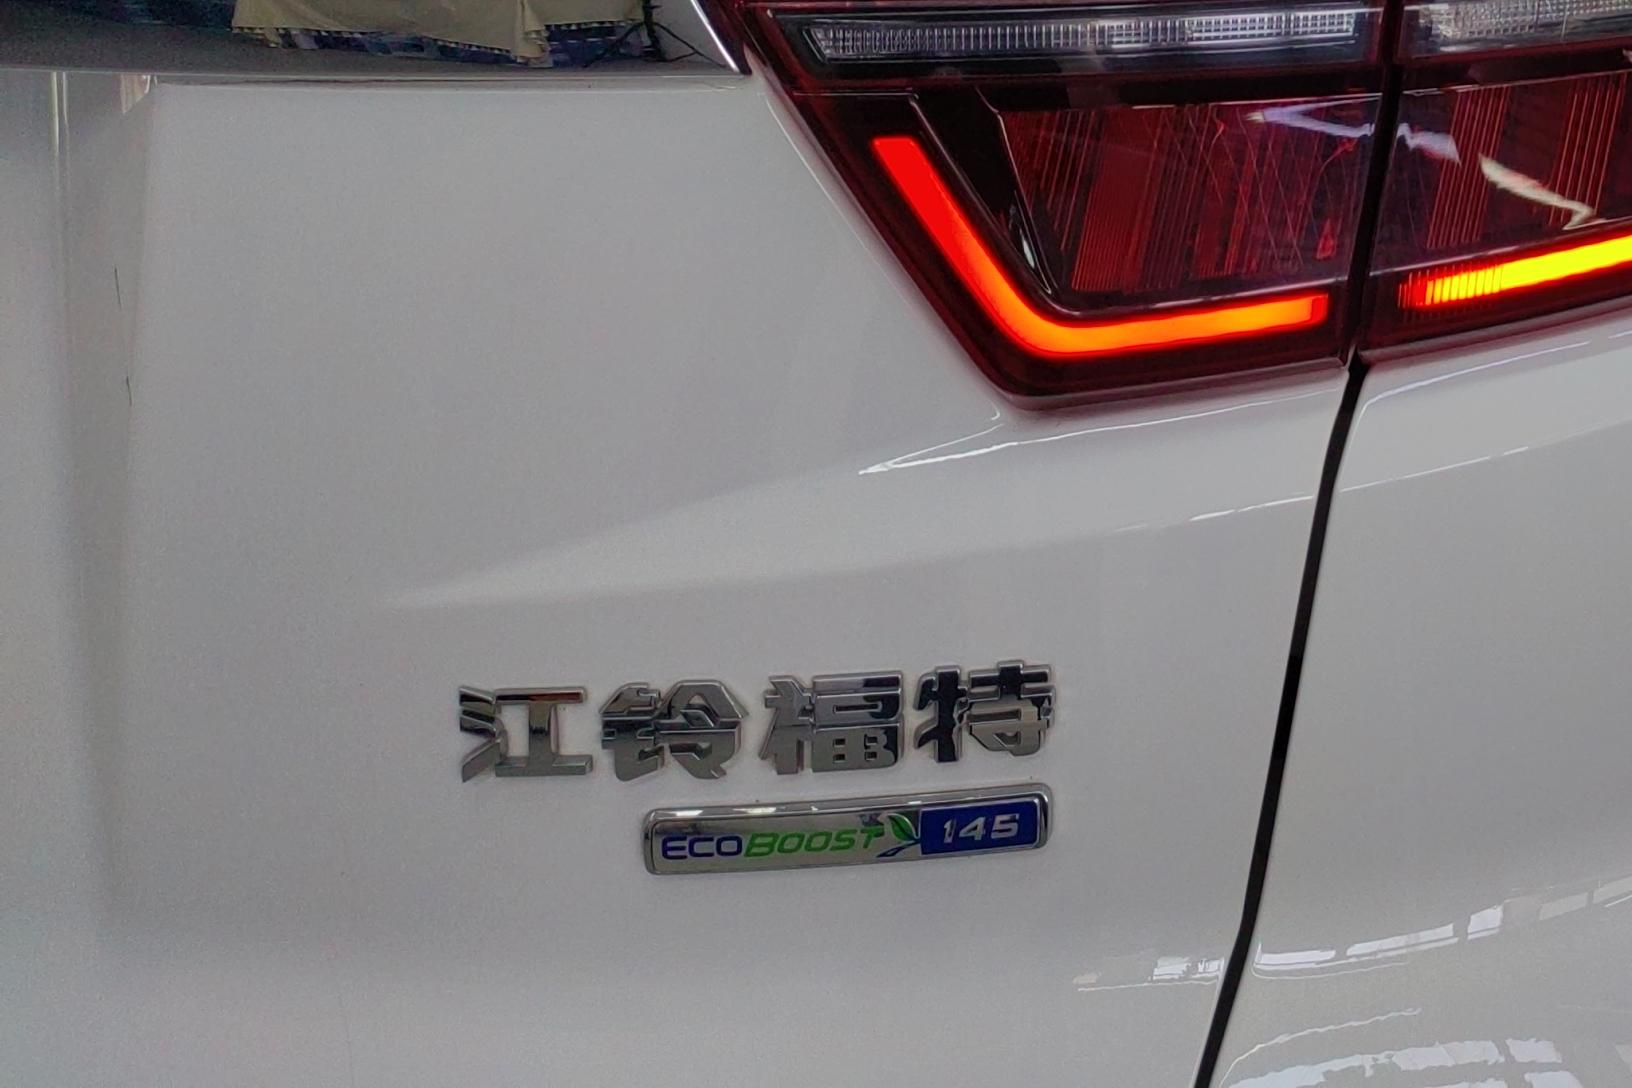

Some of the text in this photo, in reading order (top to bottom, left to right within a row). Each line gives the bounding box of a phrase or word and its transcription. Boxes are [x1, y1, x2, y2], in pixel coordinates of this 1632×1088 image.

[459, 659, 1057, 783] 江铃福特
[661, 813, 1020, 861] ECOBOOST 145
